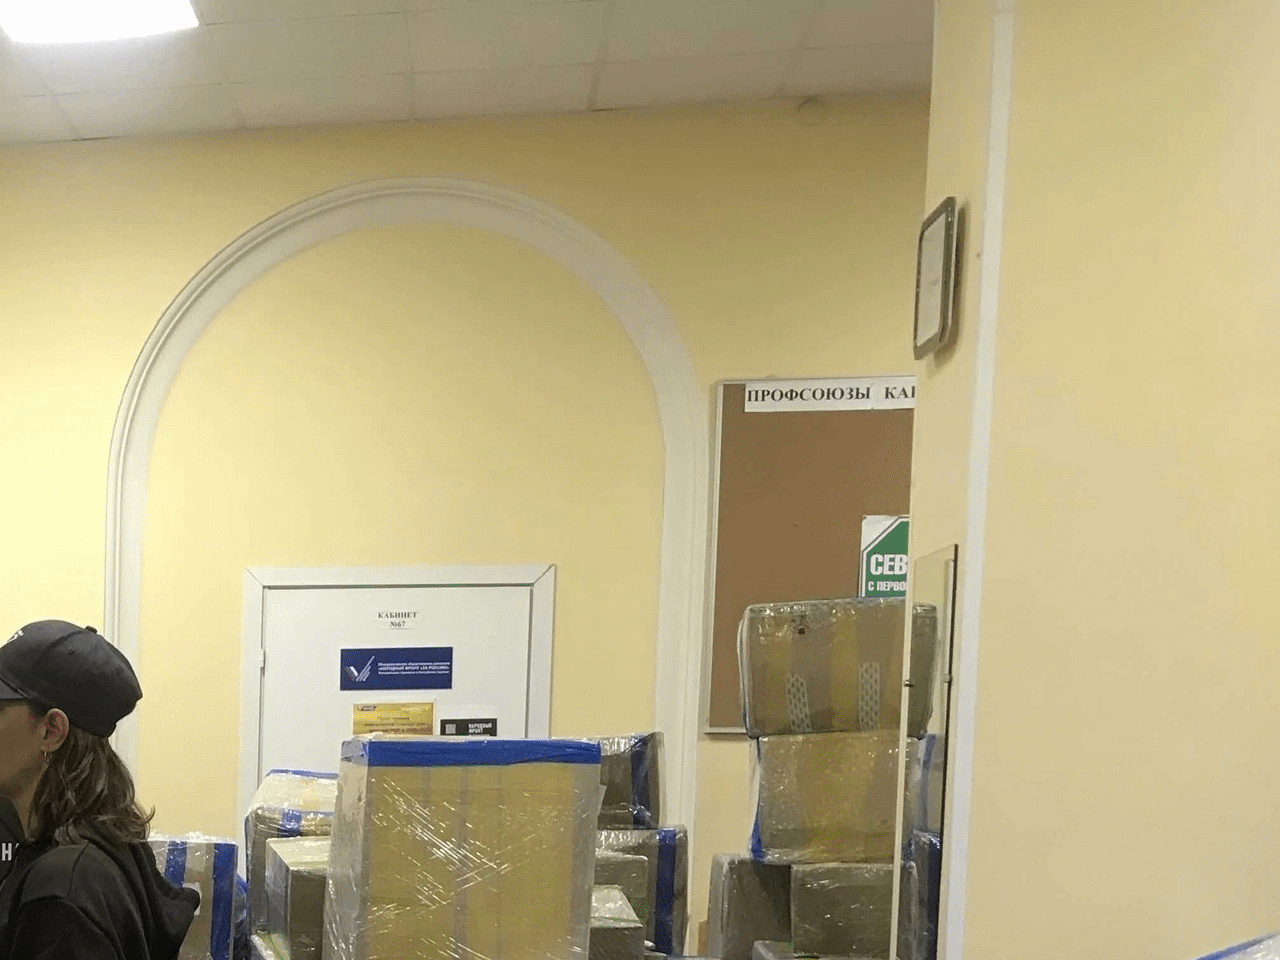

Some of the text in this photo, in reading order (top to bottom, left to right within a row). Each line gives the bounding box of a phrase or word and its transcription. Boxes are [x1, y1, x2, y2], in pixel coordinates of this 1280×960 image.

[747, 387, 871, 402] ПРОФСОЮЗЫ
[870, 554, 908, 575] СЕВ
[868, 581, 875, 591] С
[378, 611, 418, 619] КАБИНЕТ
[2, 843, 19, 861] Н
